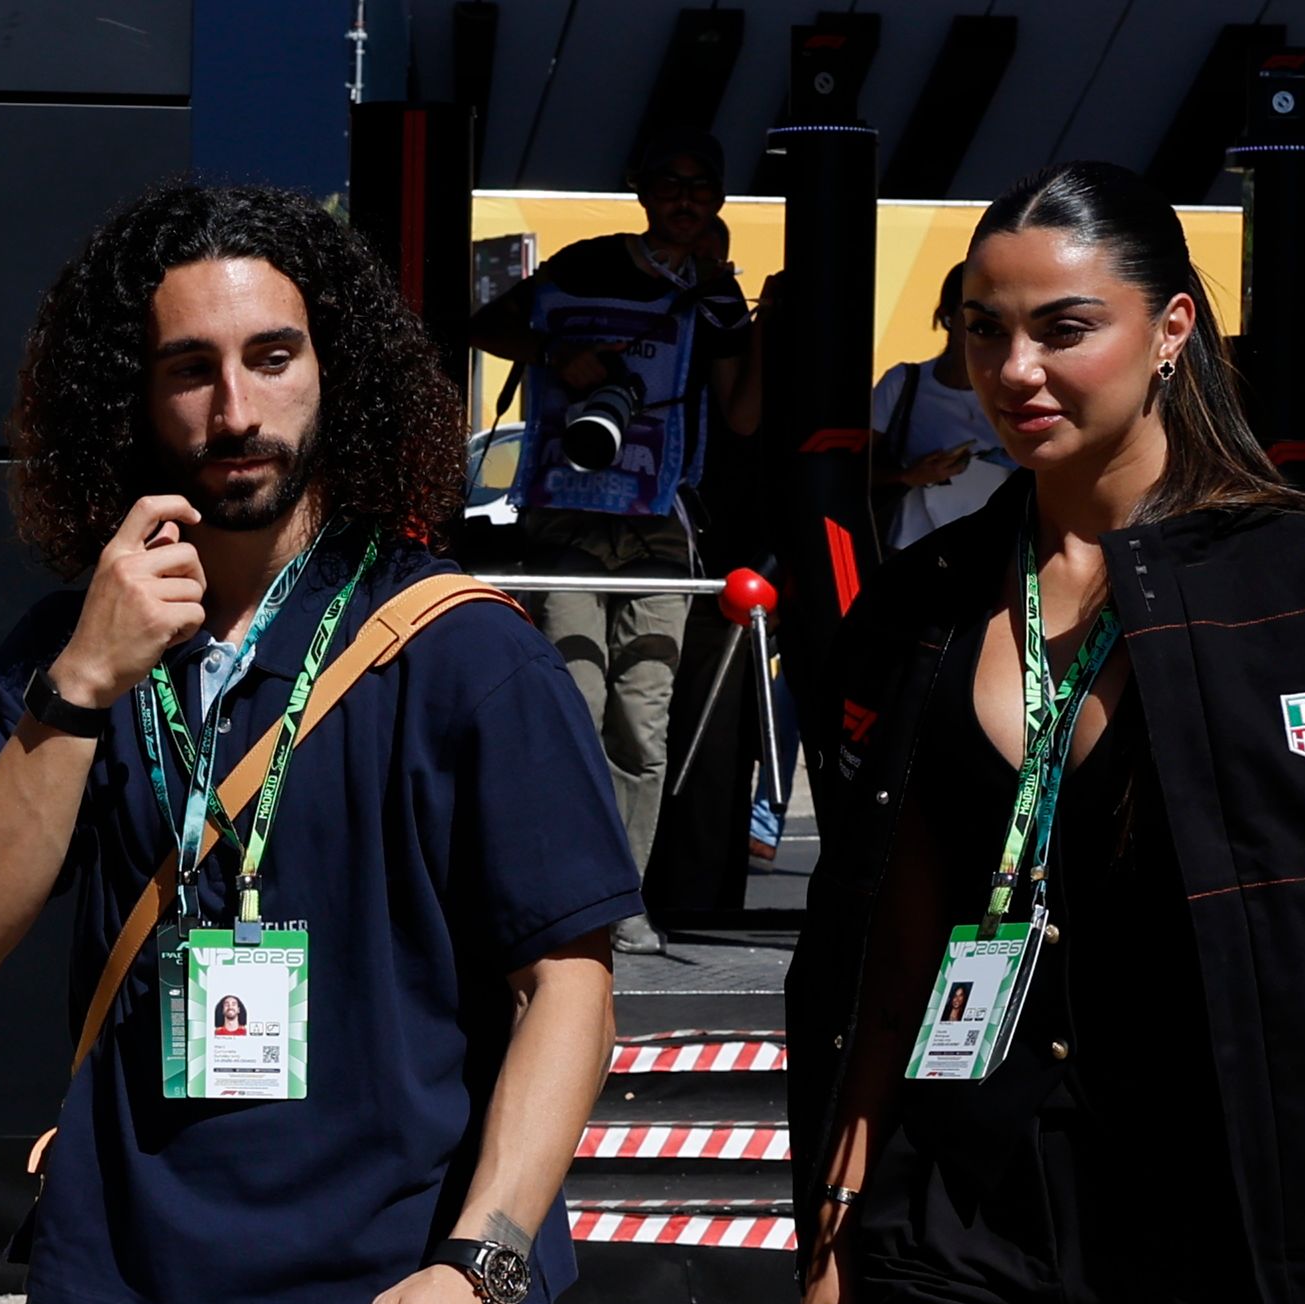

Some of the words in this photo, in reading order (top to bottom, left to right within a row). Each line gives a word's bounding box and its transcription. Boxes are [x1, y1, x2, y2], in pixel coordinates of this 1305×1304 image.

[157, 682, 178, 723] VIP
[285, 670, 314, 715] VIP
[1025, 670, 1042, 713] VIP
[259, 774, 279, 819] MADRID
[235, 948, 304, 966] 2026
